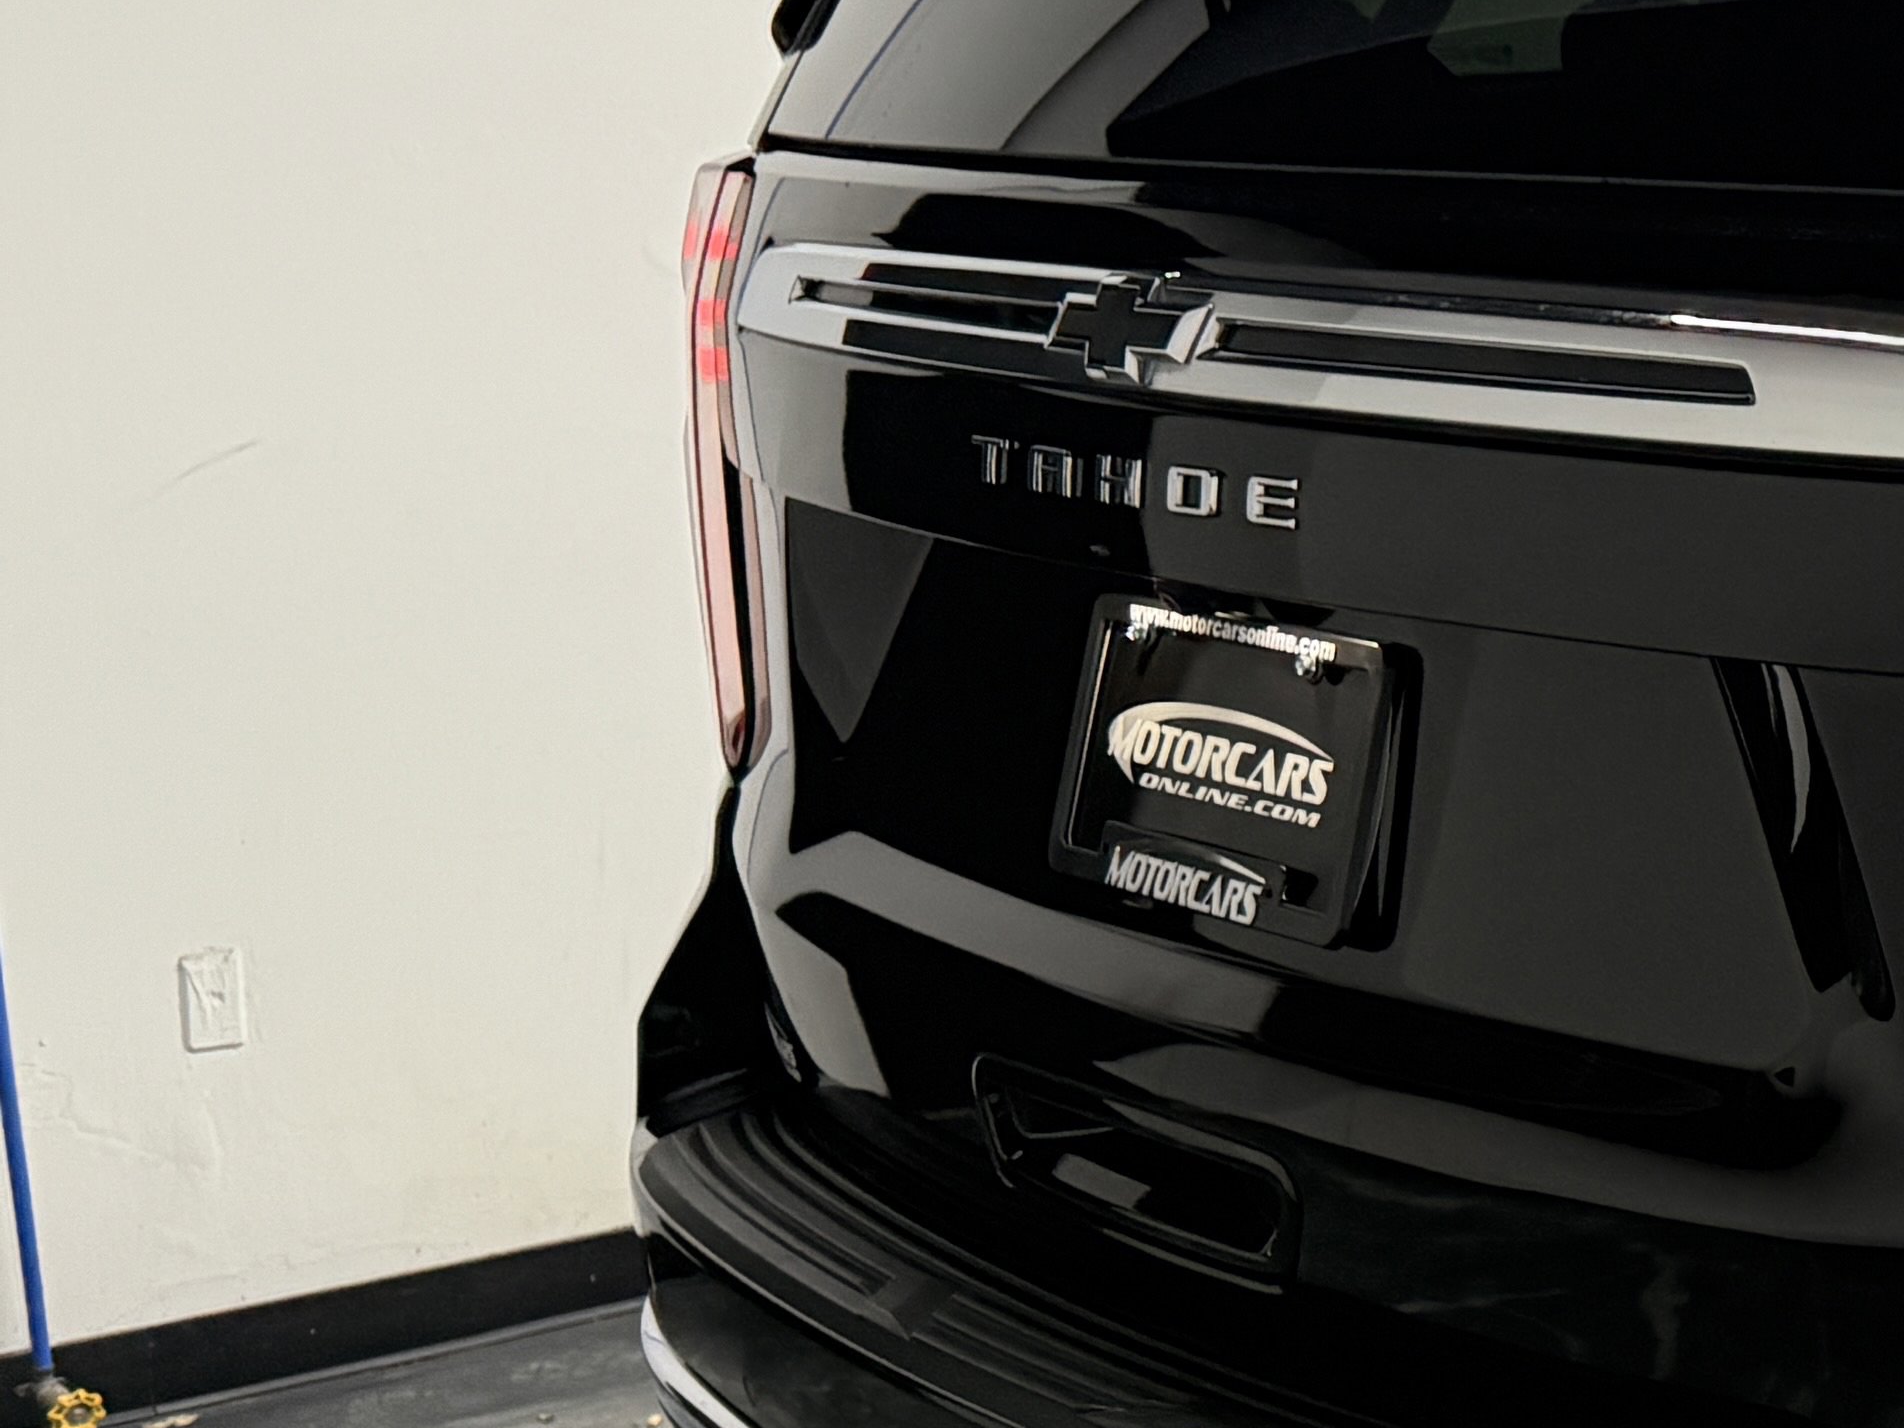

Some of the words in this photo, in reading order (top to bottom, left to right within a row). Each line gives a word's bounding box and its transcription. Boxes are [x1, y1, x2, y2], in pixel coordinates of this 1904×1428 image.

[971, 434, 1299, 530] TAHOE
[1107, 715, 1335, 806] MOTORCARS
[1139, 772, 1322, 828] ONLINE.COM
[1104, 845, 1264, 926] MOTORCARS
